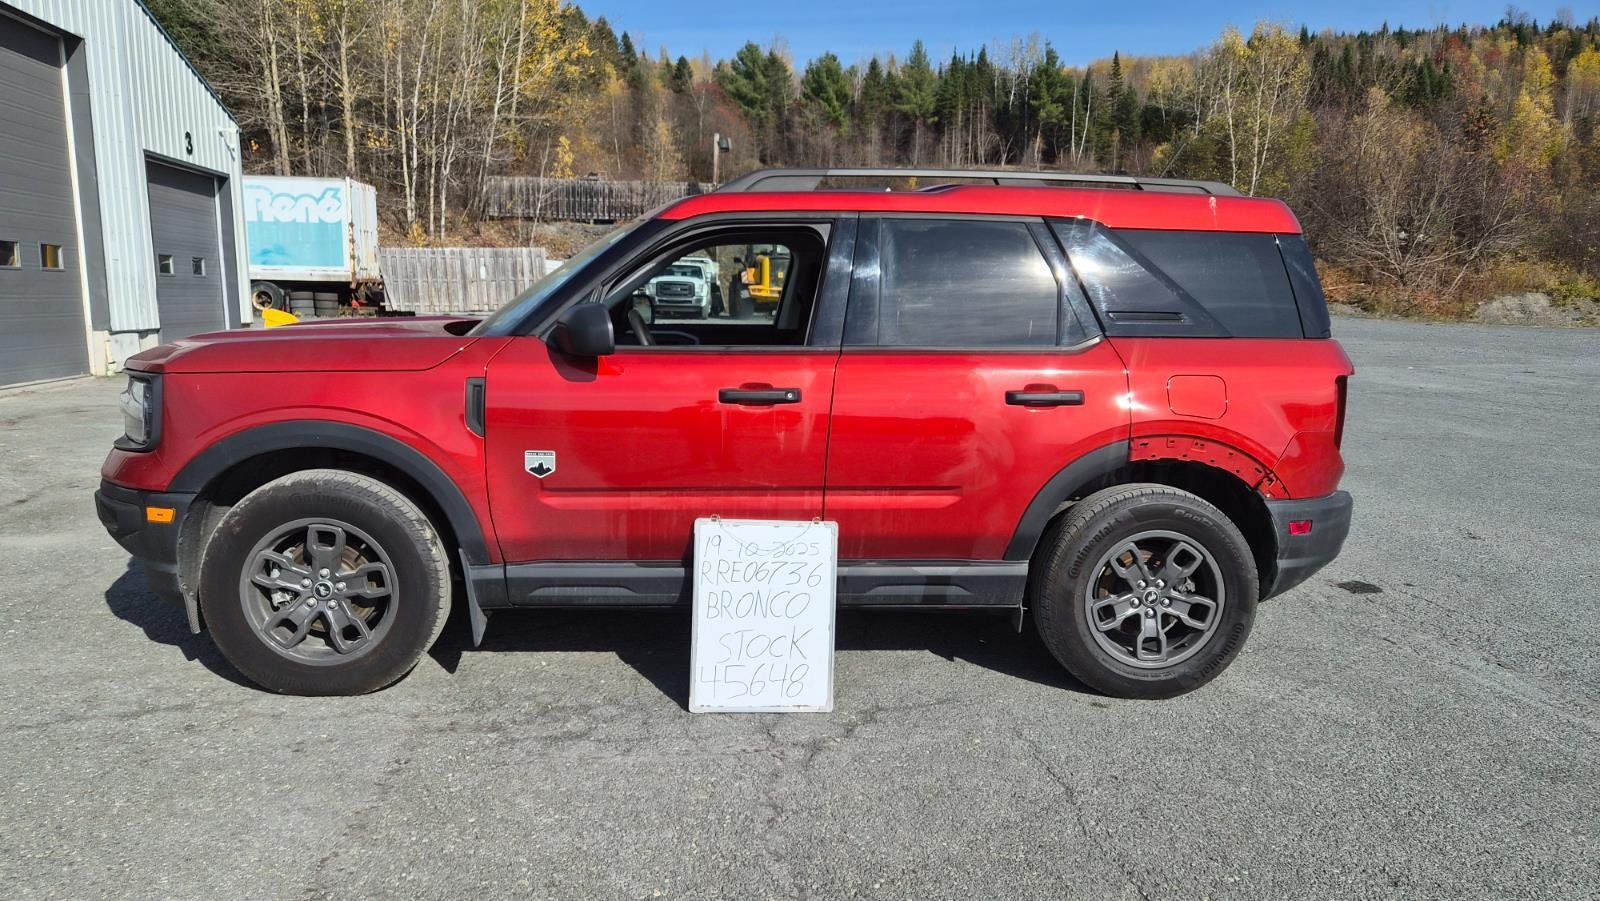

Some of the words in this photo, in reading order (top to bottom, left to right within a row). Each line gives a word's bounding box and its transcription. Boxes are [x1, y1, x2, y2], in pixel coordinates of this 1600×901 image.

[185, 131, 193, 156] 3
[245, 186, 342, 223] René
[700, 558, 823, 587] RRE06736
[706, 589, 810, 620] BRONCO
[717, 624, 815, 663] STOCK
[697, 663, 809, 699] 45648
